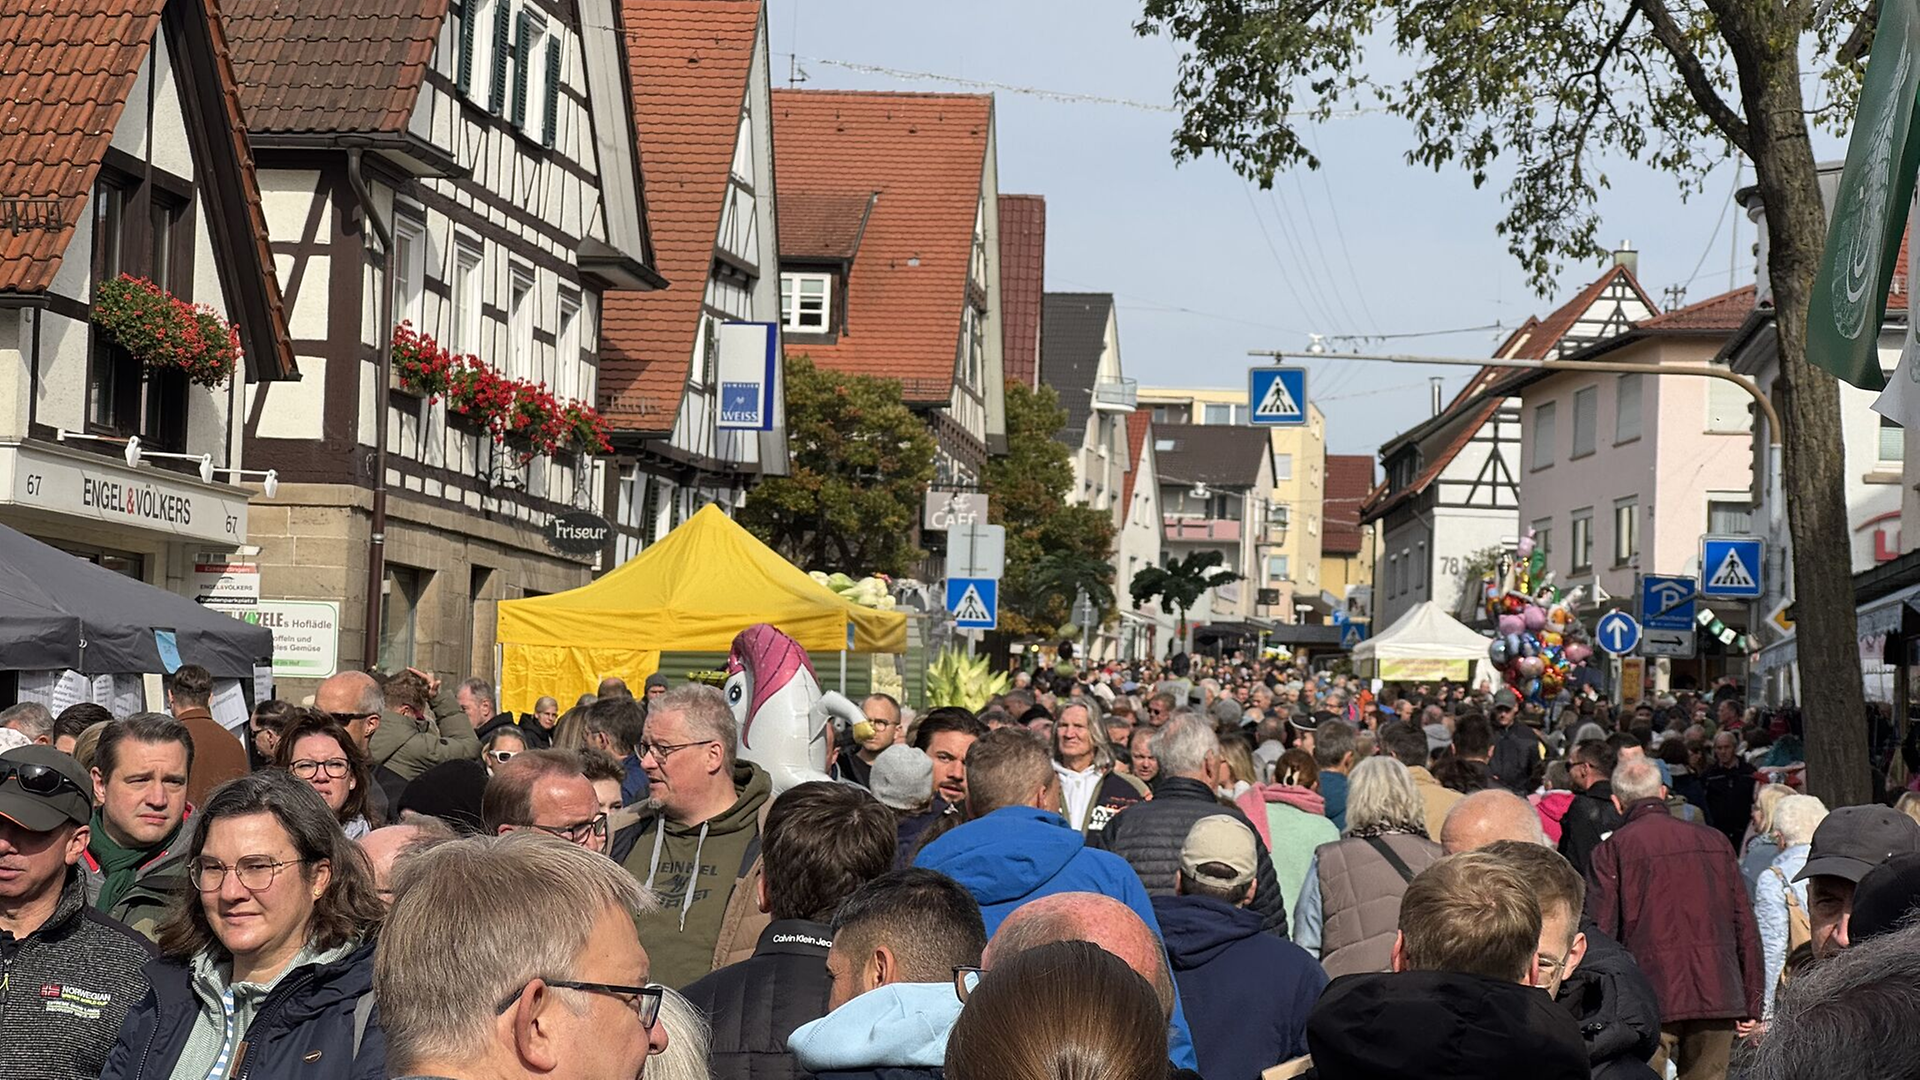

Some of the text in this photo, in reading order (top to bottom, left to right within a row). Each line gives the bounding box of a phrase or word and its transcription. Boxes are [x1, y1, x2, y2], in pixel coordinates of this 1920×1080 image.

[722, 411, 758, 421] WEISS
[26, 474, 42, 496] 67
[225, 515, 238, 534] 67
[554, 519, 608, 540] Friseur
[1439, 556, 1460, 576] 78
[292, 619, 332, 629] Hoflädle
[289, 644, 321, 652] Gemüse
[773, 934, 796, 943] Calvin
[796, 934, 816, 945] Klein
[62, 985, 111, 1001] NORWEGIAN
